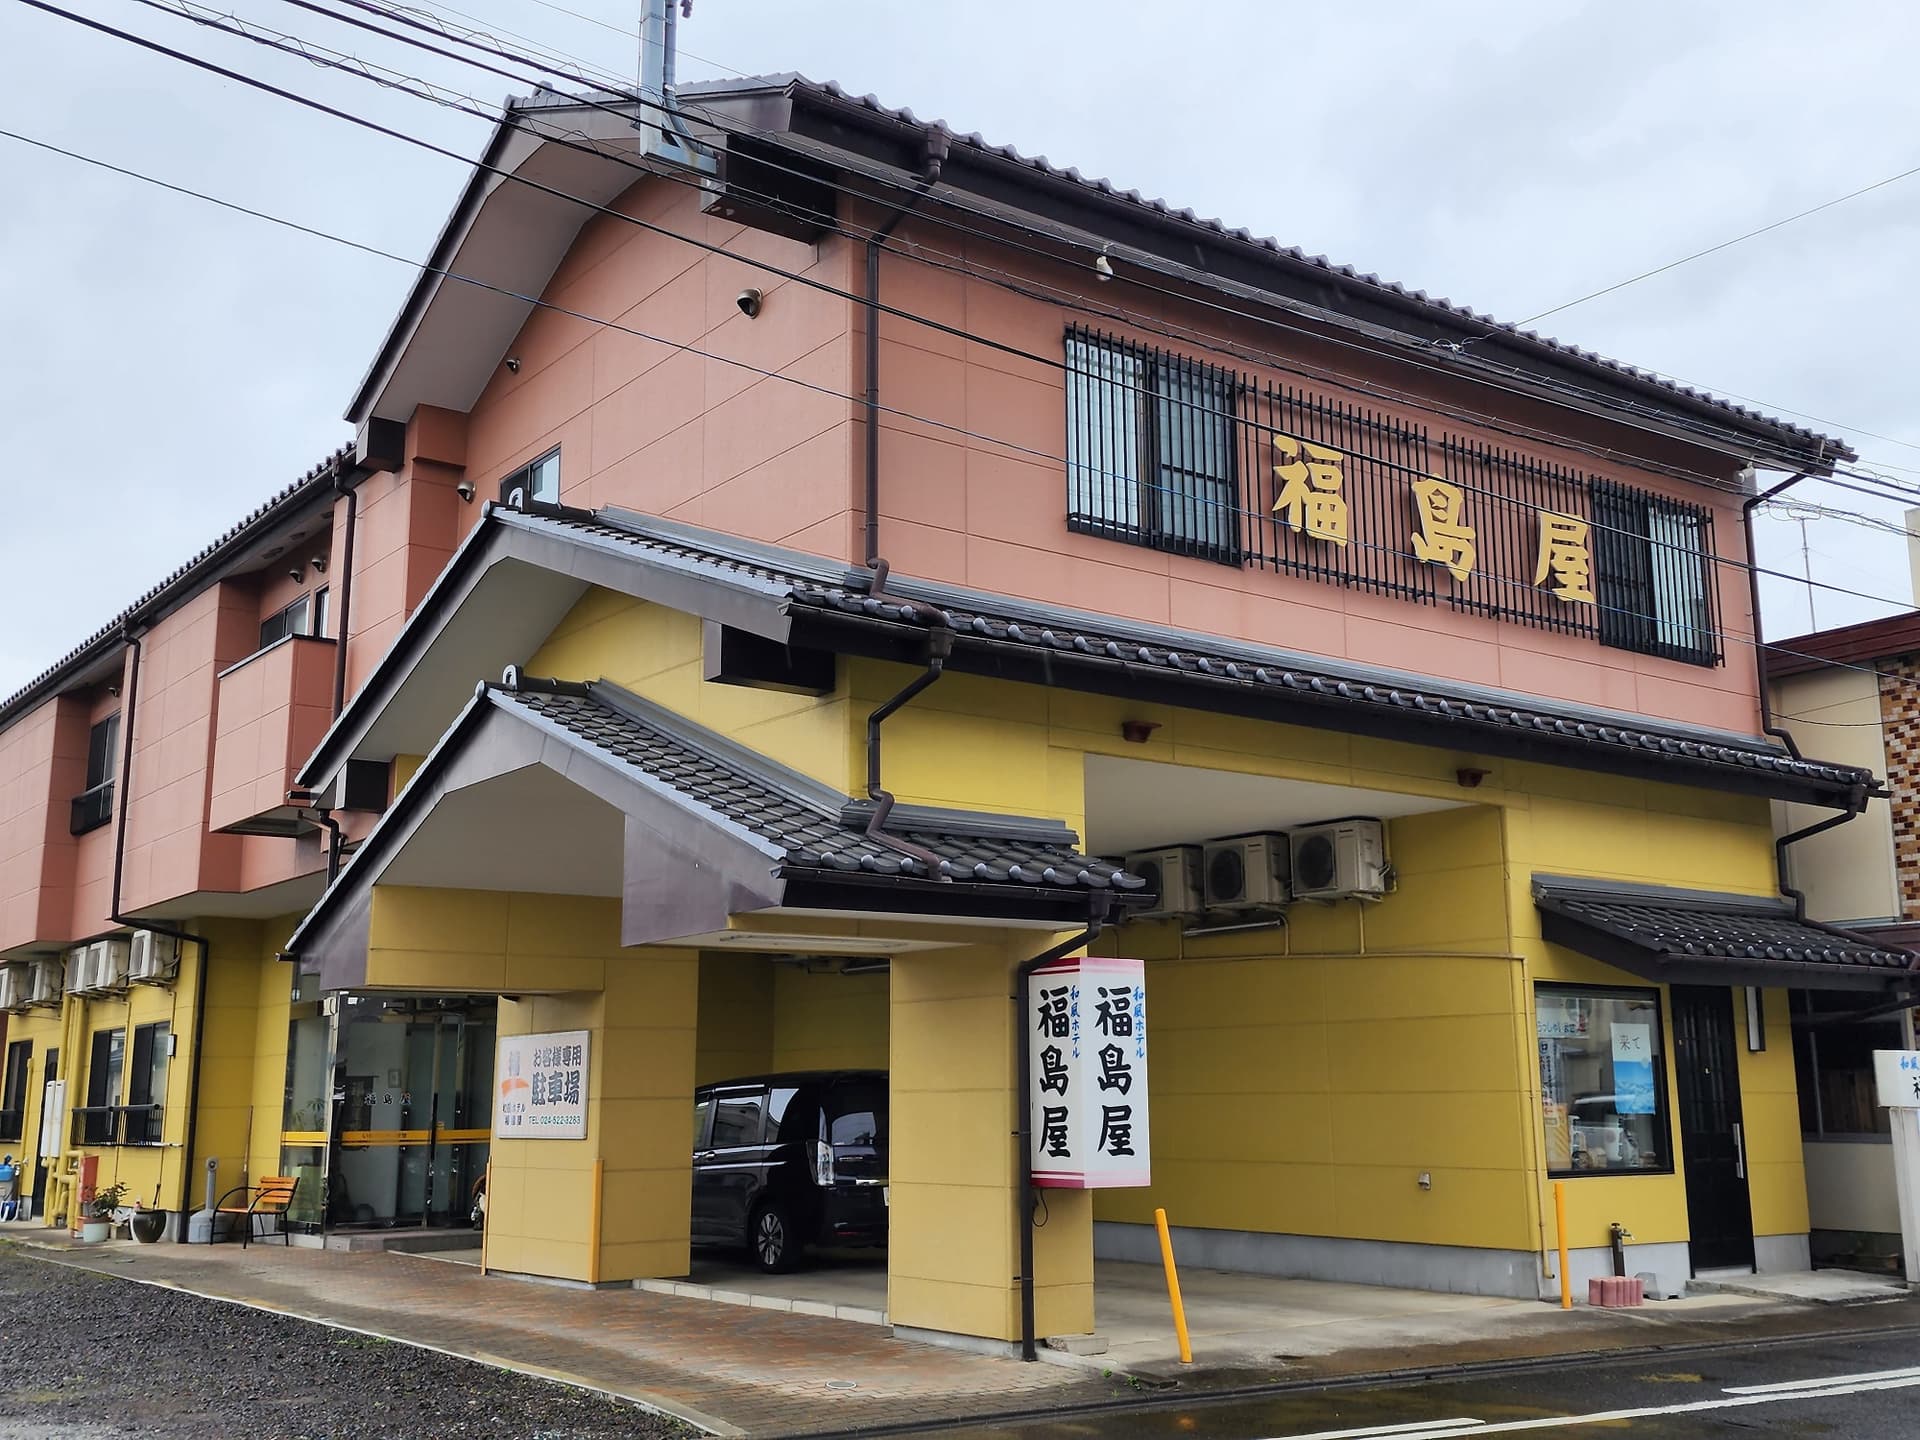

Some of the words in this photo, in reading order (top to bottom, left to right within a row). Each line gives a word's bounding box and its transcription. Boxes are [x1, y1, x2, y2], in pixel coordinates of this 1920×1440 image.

[1272, 434, 1595, 604] 福島屋
[534, 1045, 582, 1067] お客様専用
[1070, 985, 1080, 1058] 和風ホテル
[1133, 985, 1145, 1059] 和風ホテル
[532, 1070, 580, 1106] 駐車場
[1037, 985, 1071, 1158] 福島屋
[1094, 985, 1135, 1157] 福島屋
[529, 1115, 539, 1125] TEL
